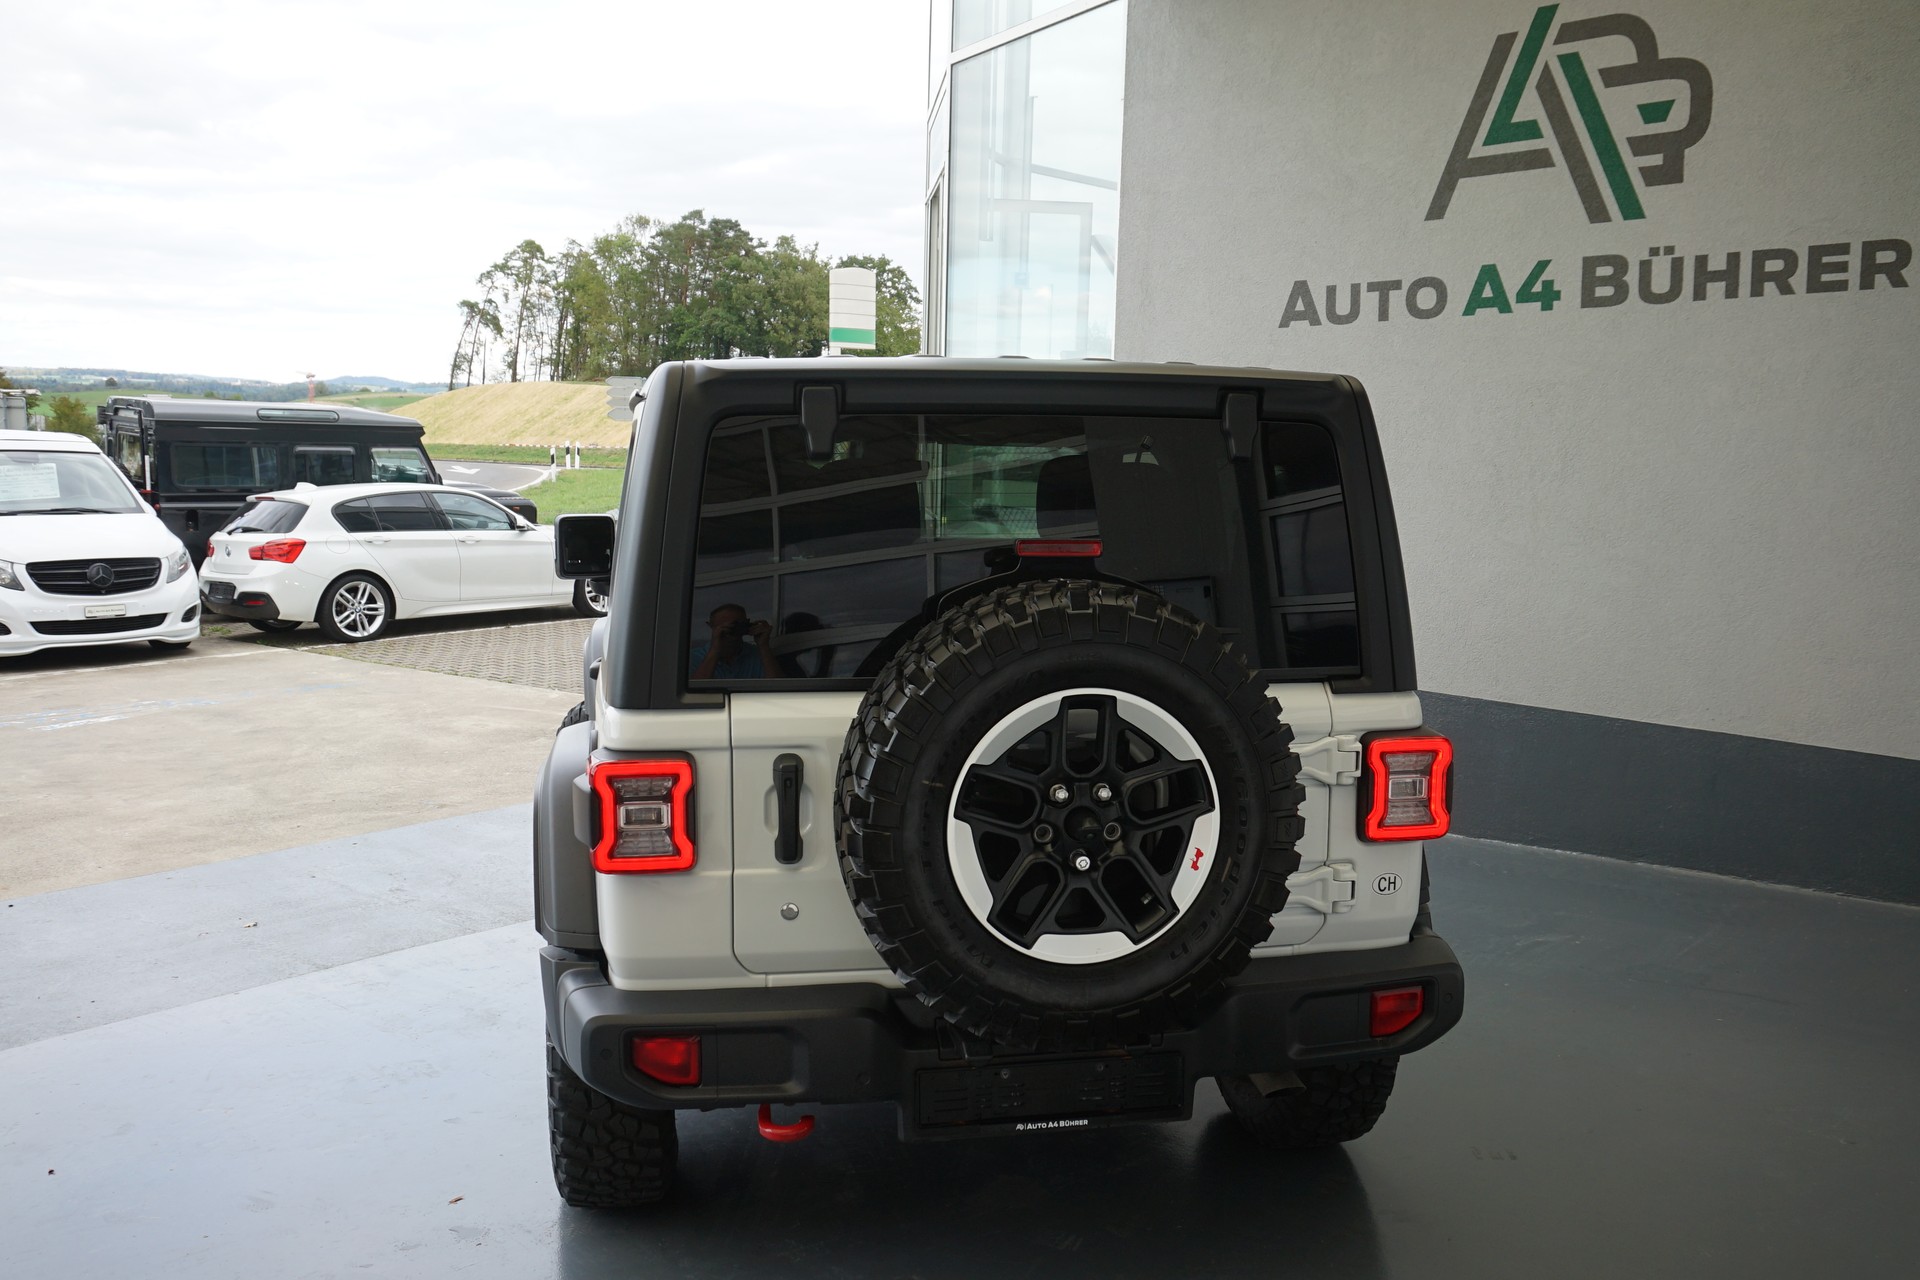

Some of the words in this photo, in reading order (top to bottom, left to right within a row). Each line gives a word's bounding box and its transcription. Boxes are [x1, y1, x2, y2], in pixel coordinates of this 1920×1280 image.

[1277, 275, 1449, 329] AUTO
[1461, 259, 1562, 317] A4
[1580, 238, 1911, 309] BÜHRER
[1377, 875, 1397, 892] CH
[1060, 1119, 1088, 1127] BÜHRER
